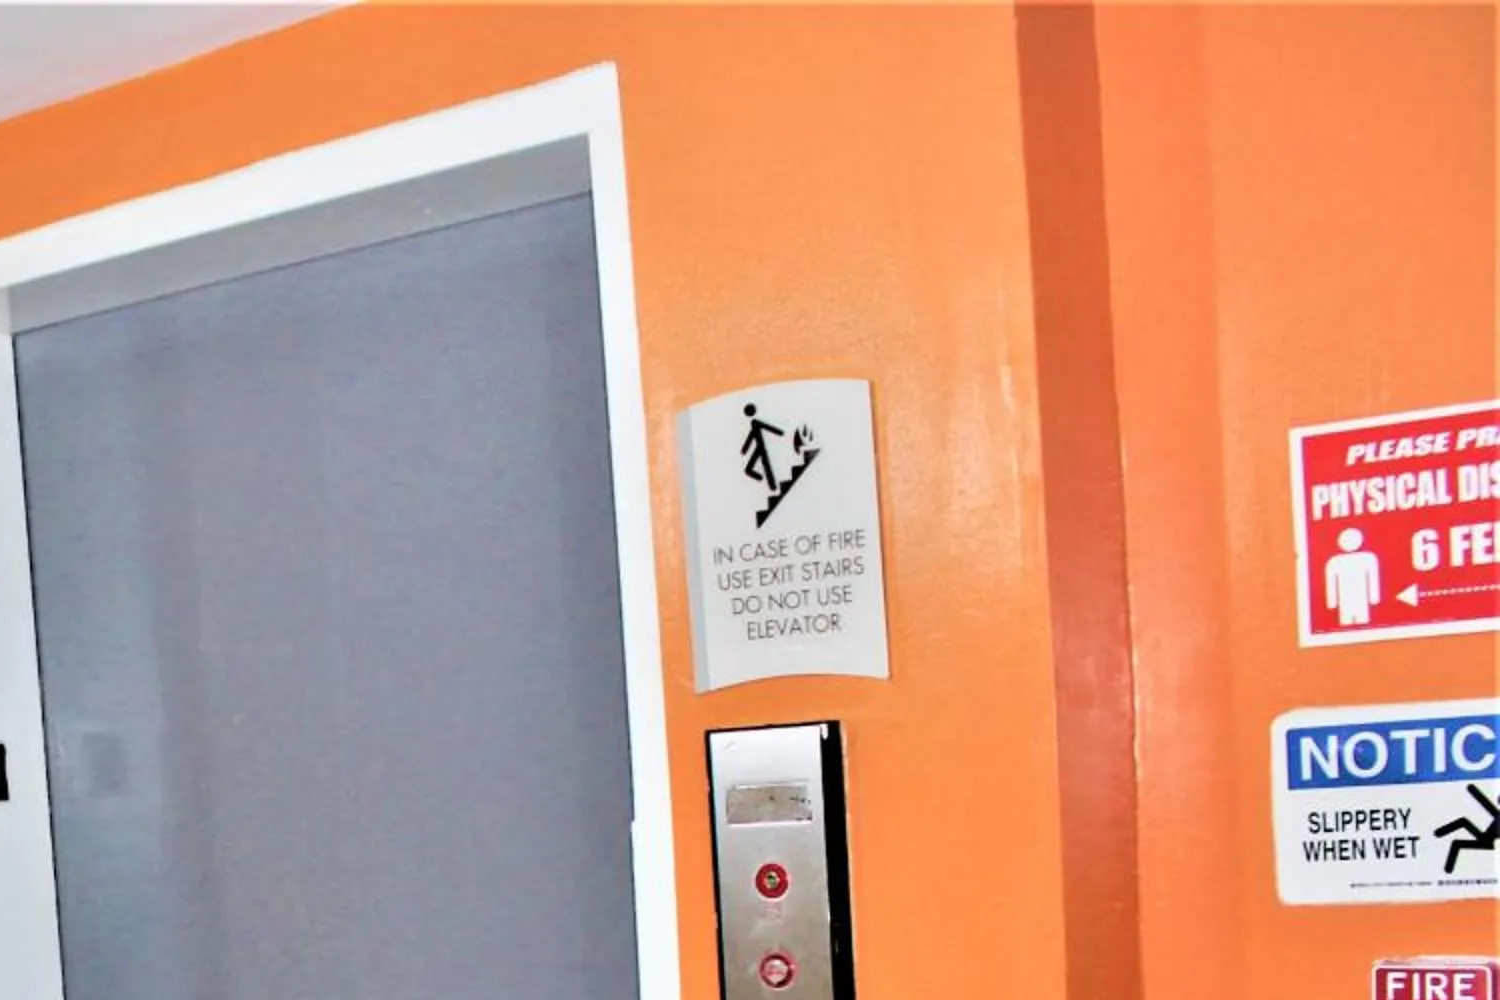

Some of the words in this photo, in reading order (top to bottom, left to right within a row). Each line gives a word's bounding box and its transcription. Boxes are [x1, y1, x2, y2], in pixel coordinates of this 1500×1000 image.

[1346, 432, 1450, 466] PLEASE
[1311, 468, 1452, 521] PHYSICAL
[713, 547, 733, 565] IN
[739, 539, 788, 562] CASE
[794, 534, 821, 556] OF
[829, 530, 865, 551] FIRE
[1411, 528, 1441, 572] 6
[717, 570, 752, 591] USE
[759, 563, 794, 587] EXIT
[801, 555, 865, 582] STAIRS
[731, 595, 762, 615] DO
[768, 588, 811, 612] NOT
[817, 584, 852, 607] USE
[747, 612, 842, 641] ELEVATOR
[1300, 723, 1497, 781] NOTIC
[1307, 807, 1412, 835] SLIPPERY
[1302, 839, 1367, 863] WHEN
[1372, 835, 1421, 860] WET
